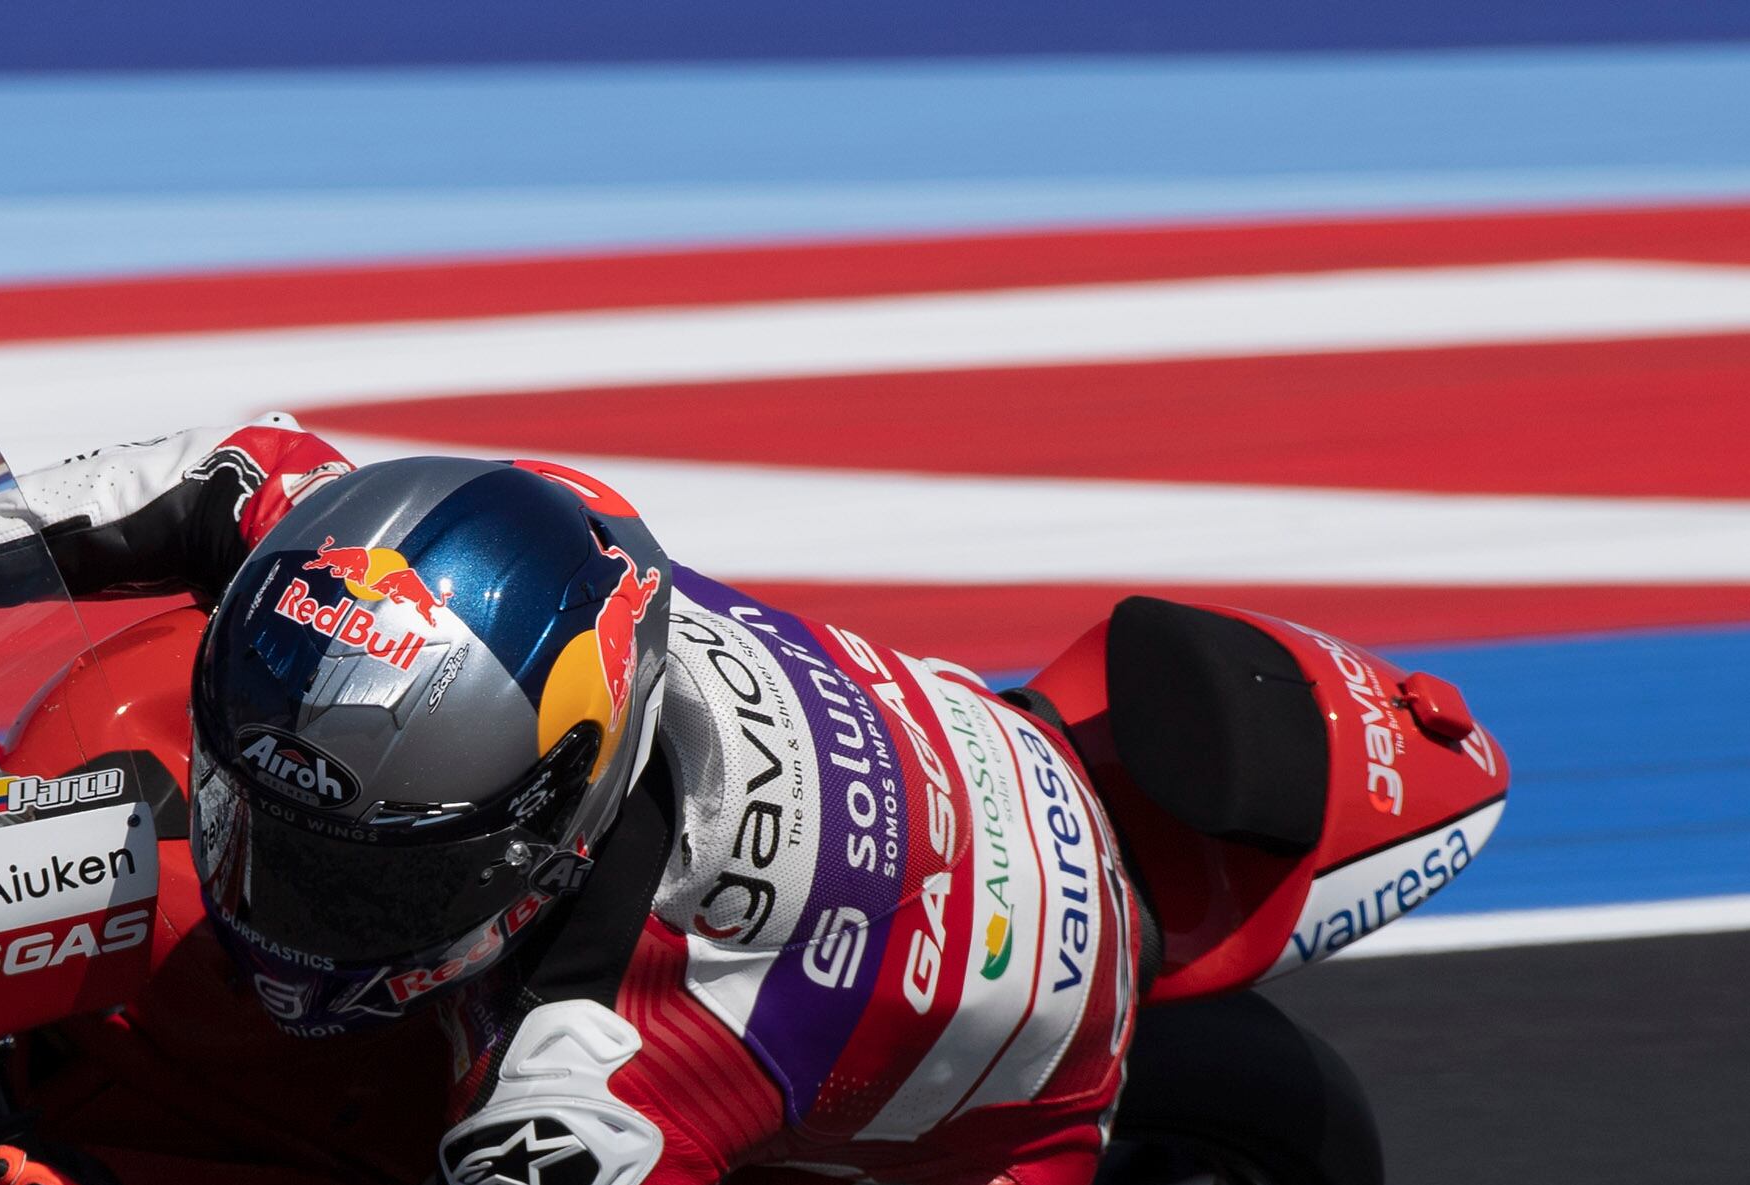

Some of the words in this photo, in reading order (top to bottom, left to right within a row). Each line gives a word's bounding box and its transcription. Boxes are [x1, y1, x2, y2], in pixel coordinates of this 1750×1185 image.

[274, 577, 354, 637] Red
[337, 608, 426, 671] Bull
[242, 735, 342, 800] Airoh
[729, 606, 878, 875] solunin
[787, 738, 800, 751] &
[6, 768, 125, 813] Parce
[792, 760, 804, 798] Sun
[307, 817, 379, 843] WINGS
[788, 810, 803, 849] The
[882, 776, 897, 879] SOMOS
[1017, 727, 1090, 994] vairesa
[1292, 827, 1474, 963] vairesa
